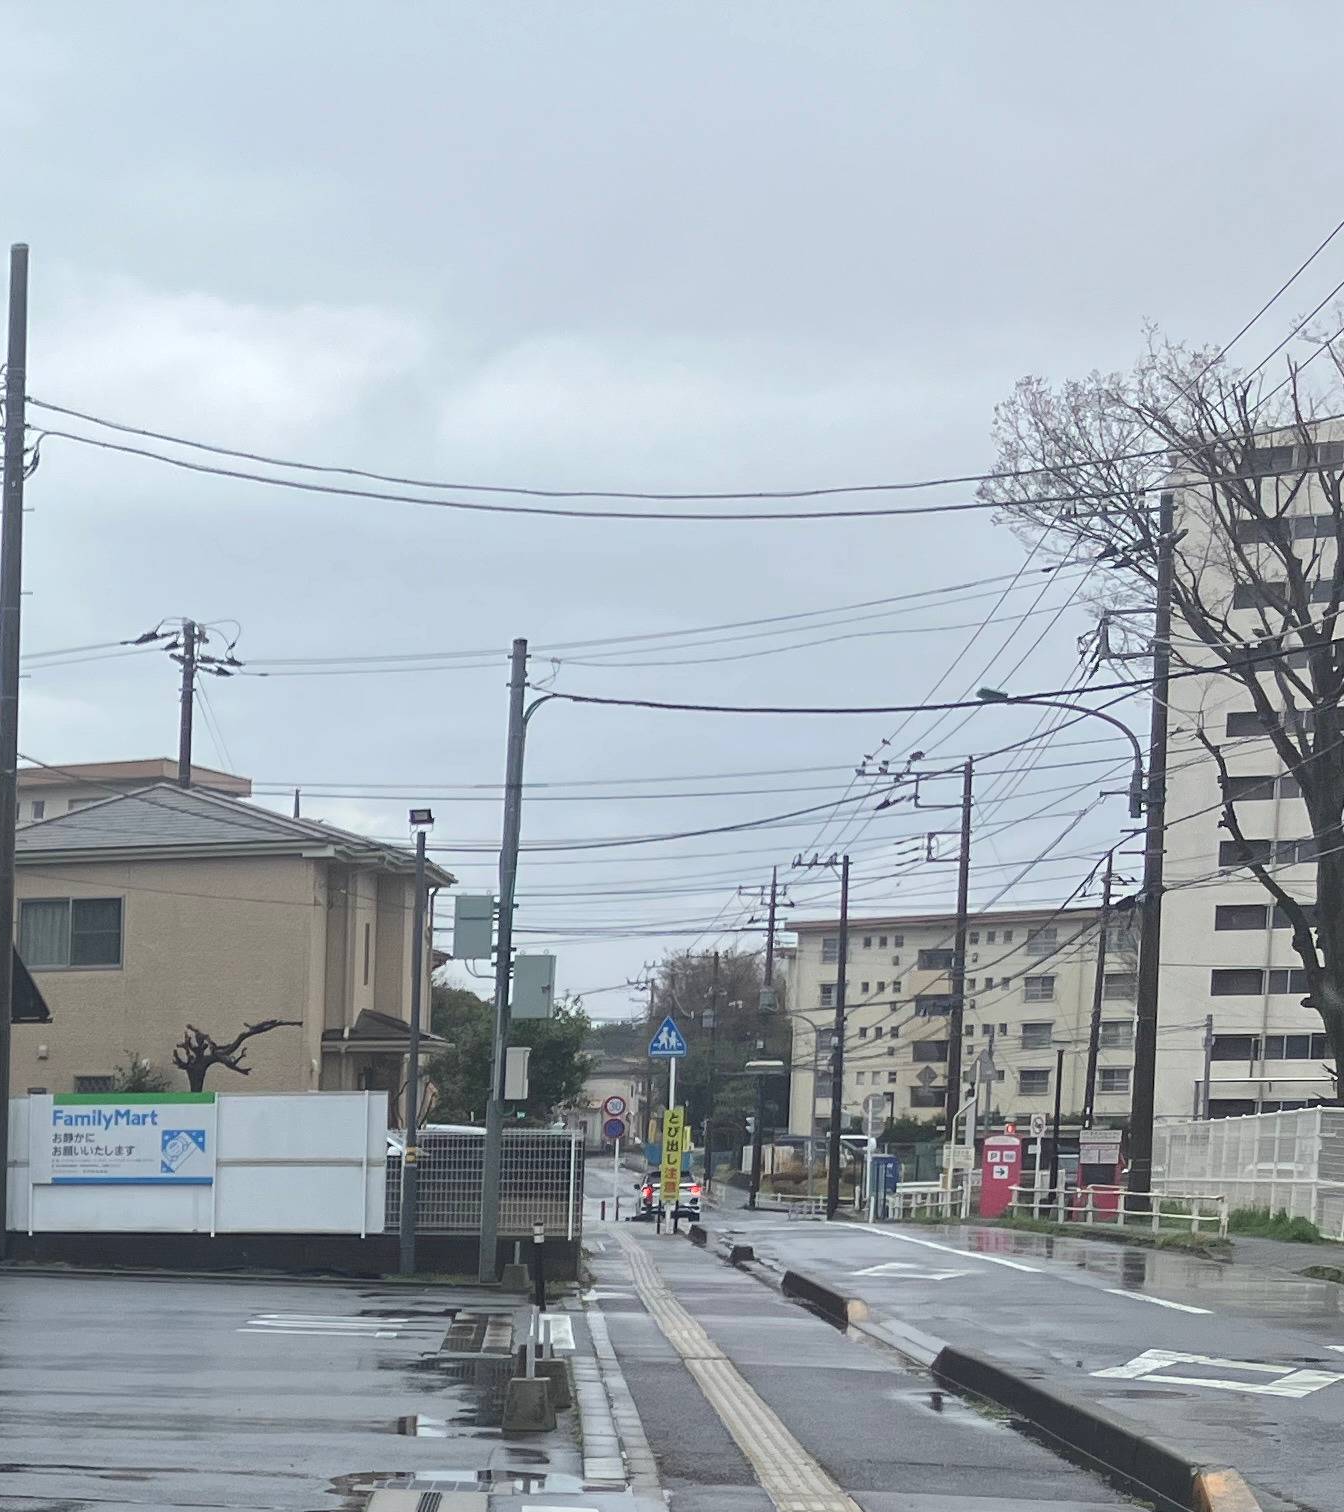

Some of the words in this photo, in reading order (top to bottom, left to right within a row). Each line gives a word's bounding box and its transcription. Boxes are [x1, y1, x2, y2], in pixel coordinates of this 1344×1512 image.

[609, 1101, 621, 1111] 30
[52, 1109, 158, 1130] FamilyMart
[51, 1132, 96, 1143] お静かに
[51, 1146, 135, 1157] お願いいたします
